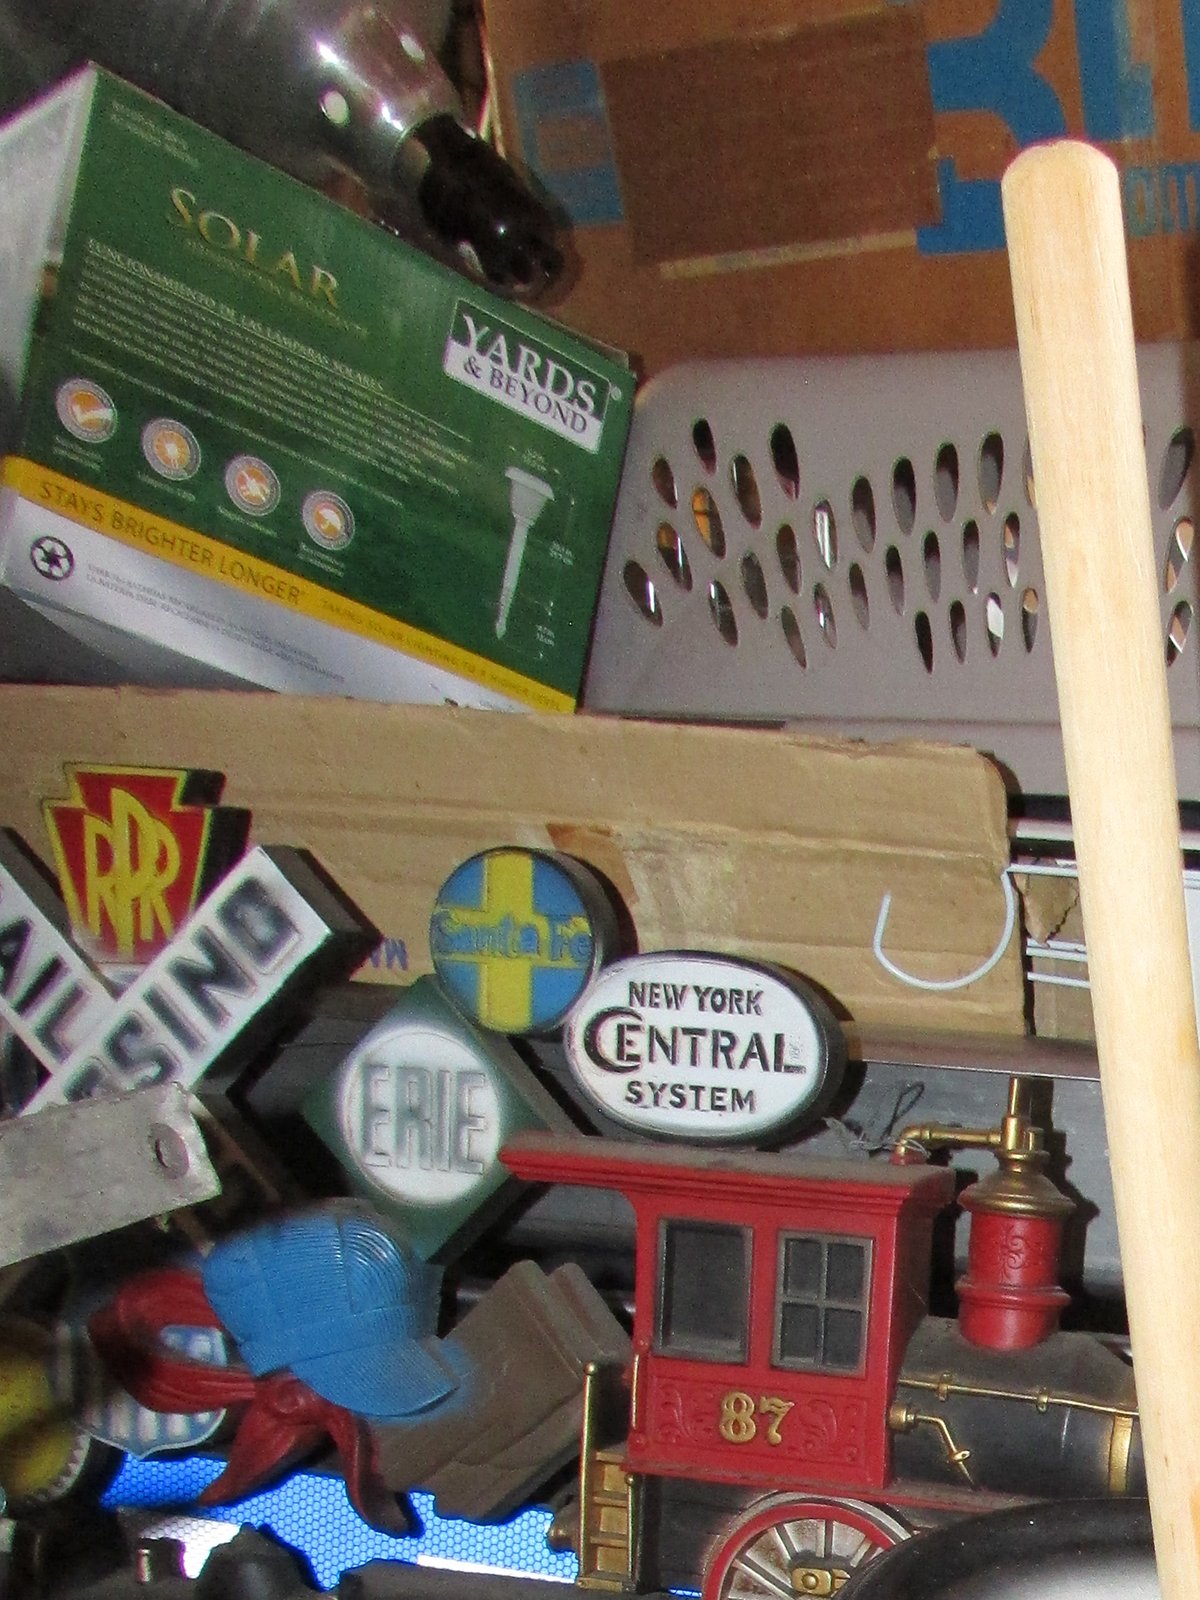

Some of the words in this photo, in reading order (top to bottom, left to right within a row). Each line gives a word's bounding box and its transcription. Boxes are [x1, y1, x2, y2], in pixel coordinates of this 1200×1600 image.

[166, 185, 340, 308] SOLAR
[462, 313, 598, 416] YARDS
[463, 355, 483, 380] &
[488, 366, 588, 434] BEYOND
[40, 481, 104, 523] STAYS
[111, 506, 213, 568] BRIGHTER
[220, 552, 301, 604] LONGER
[429, 910, 541, 959] Santa
[550, 914, 594, 963] Fe
[62, 875, 301, 1100] SING
[628, 980, 687, 1011] NEW
[692, 985, 766, 1017] YORK
[584, 1005, 808, 1075] CENTRAL
[362, 1063, 487, 1175] ERIE
[624, 1079, 759, 1115] SYSTEM
[720, 1391, 795, 1446] 87
